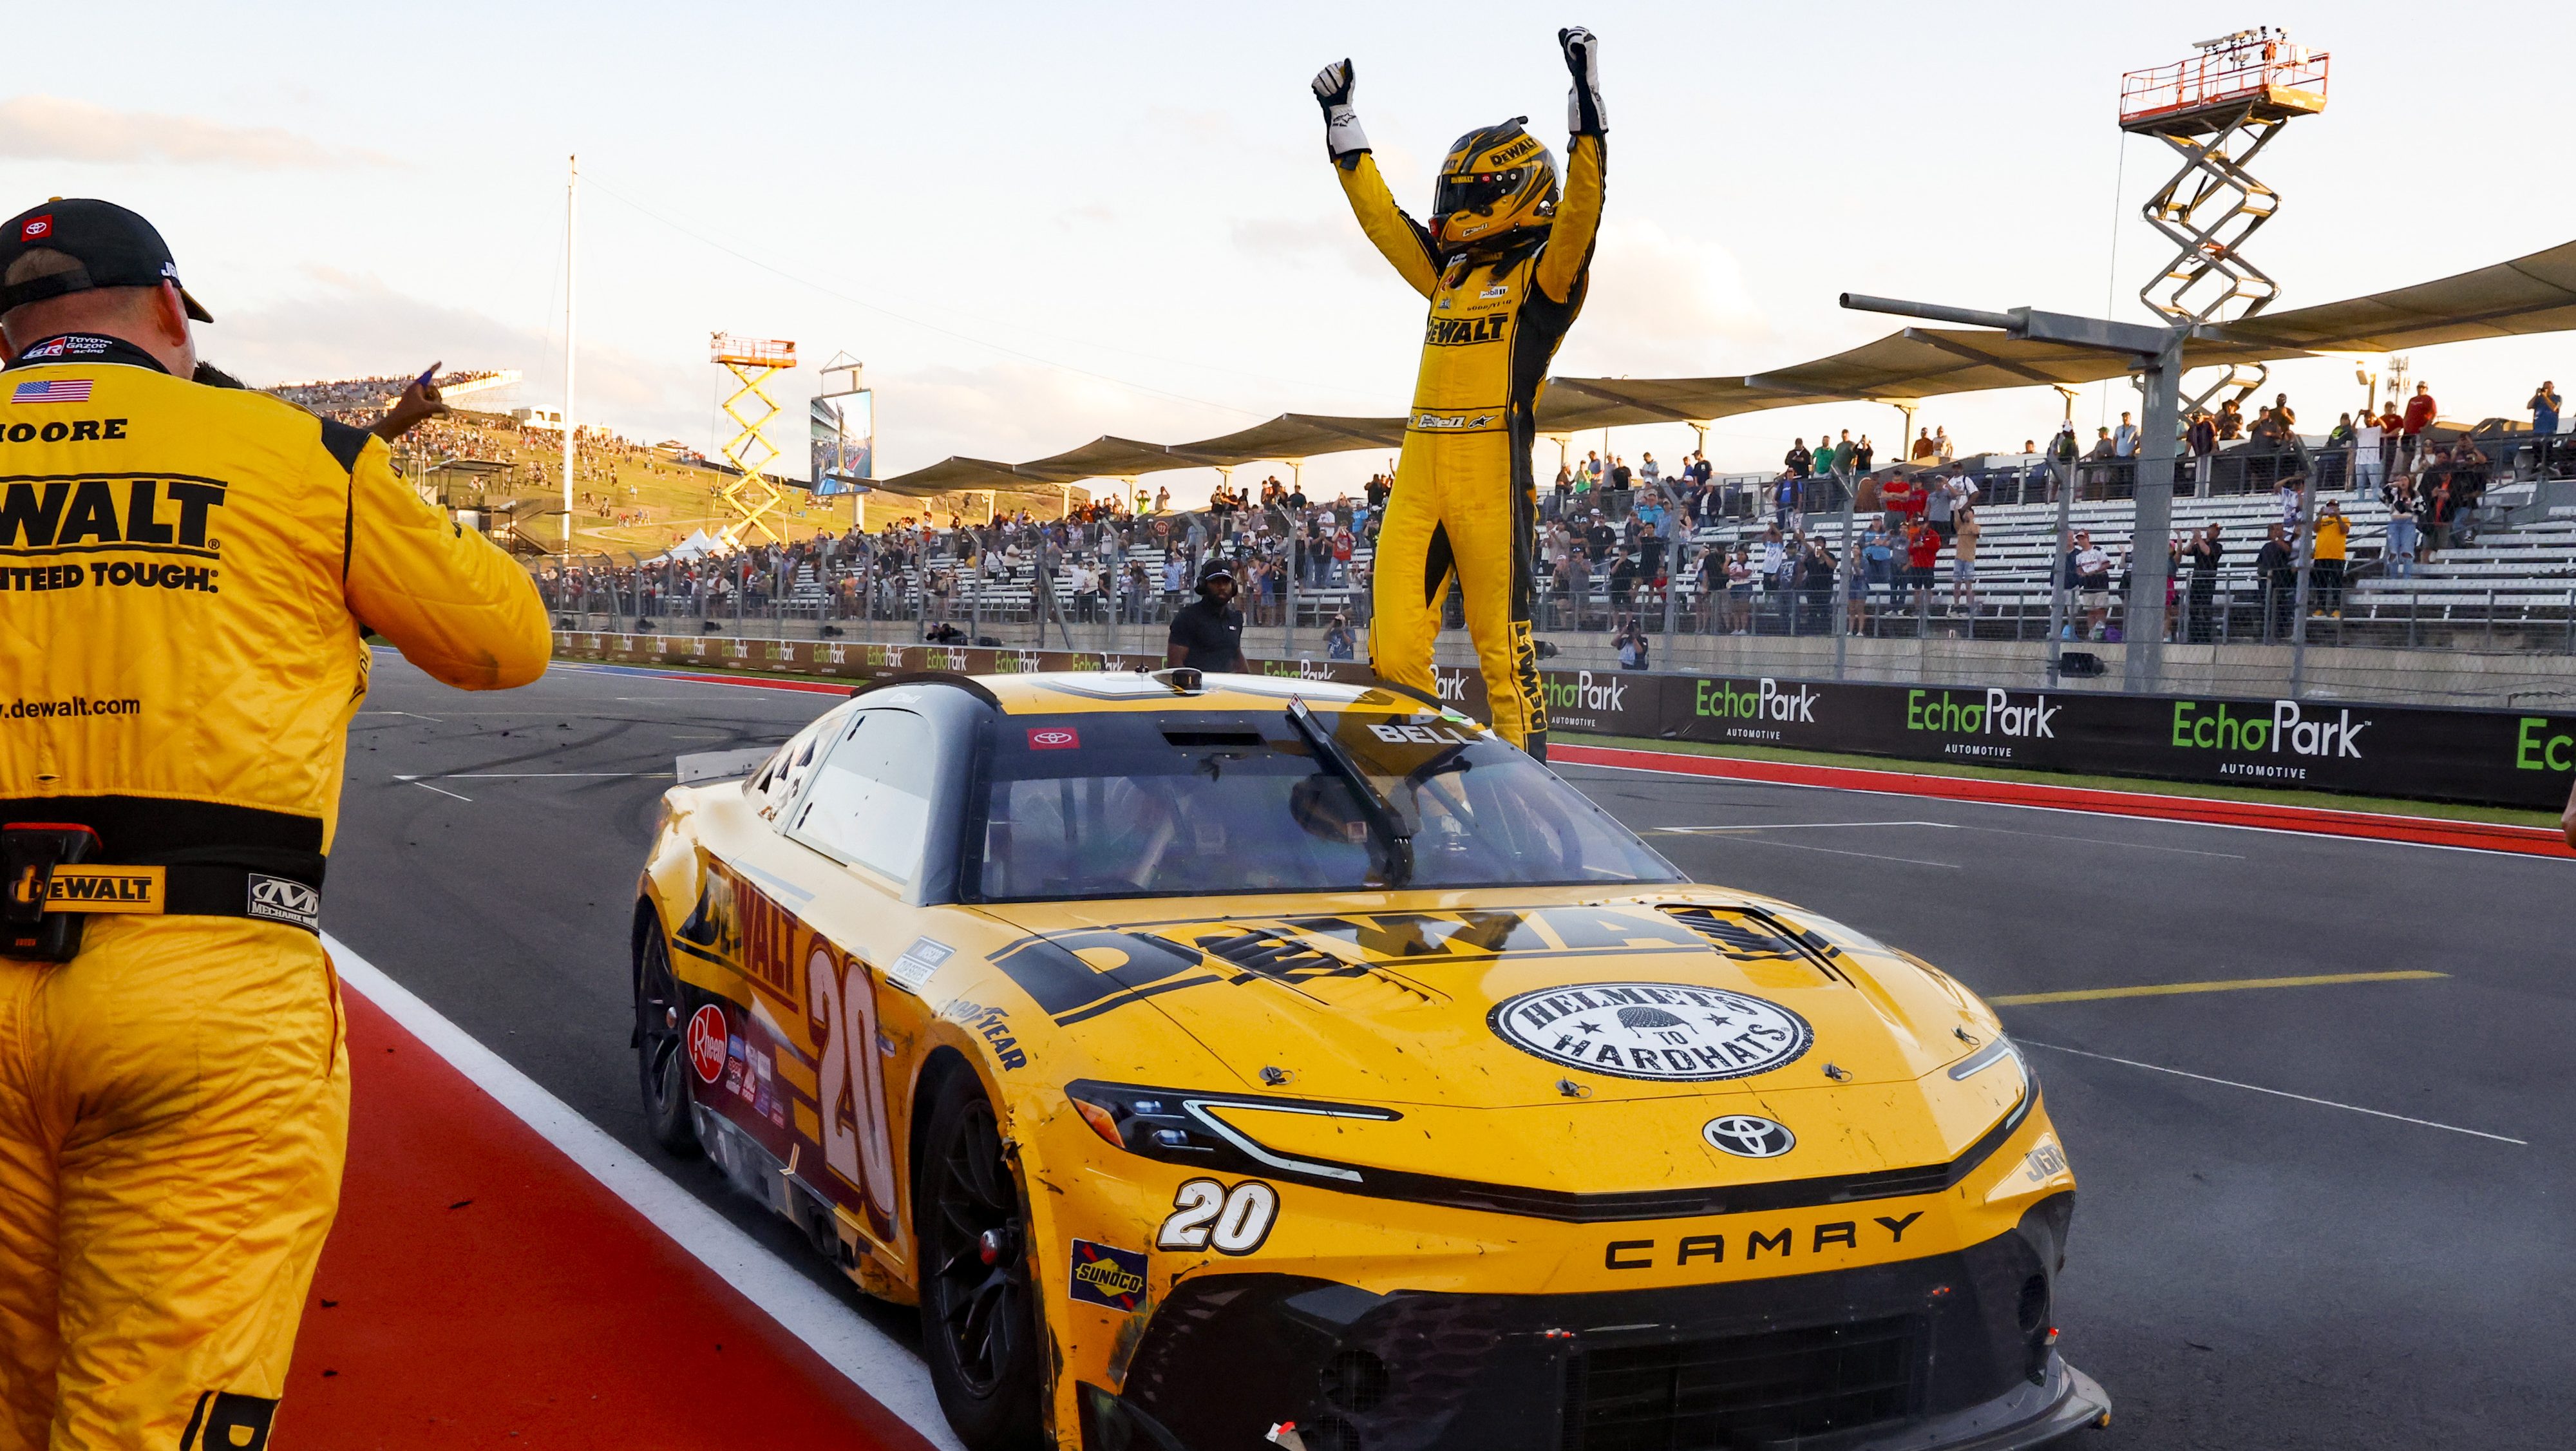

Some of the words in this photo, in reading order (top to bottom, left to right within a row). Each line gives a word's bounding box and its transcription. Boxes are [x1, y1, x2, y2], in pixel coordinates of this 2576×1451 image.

[0, 419, 128, 442] OORE
[927, 647, 967, 671] EchoPark
[0, 696, 140, 719] .dewalt.com
[1696, 678, 1817, 723] EchoPark
[1551, 716, 1596, 727] AUTOMOTIVE
[1908, 688, 2056, 739] EchoPark
[1366, 724, 1483, 745] BELL
[1727, 728, 1781, 740] AUTOMOTIVE
[2172, 700, 2363, 759] EchoPark
[1945, 744, 2012, 757] AUTOMOTIVE
[2221, 763, 2306, 779] AUTOMOTIVE
[1517, 987, 1758, 1030] HELMETS
[695, 1007, 726, 1069] Rheem
[1552, 1023, 1788, 1072] HARDHATS
[1654, 1030, 1689, 1046] TO
[1156, 1177, 1280, 1255] 20
[1605, 1211, 1924, 1271] CAMRY
[1079, 1264, 1140, 1291] SUNOCO
